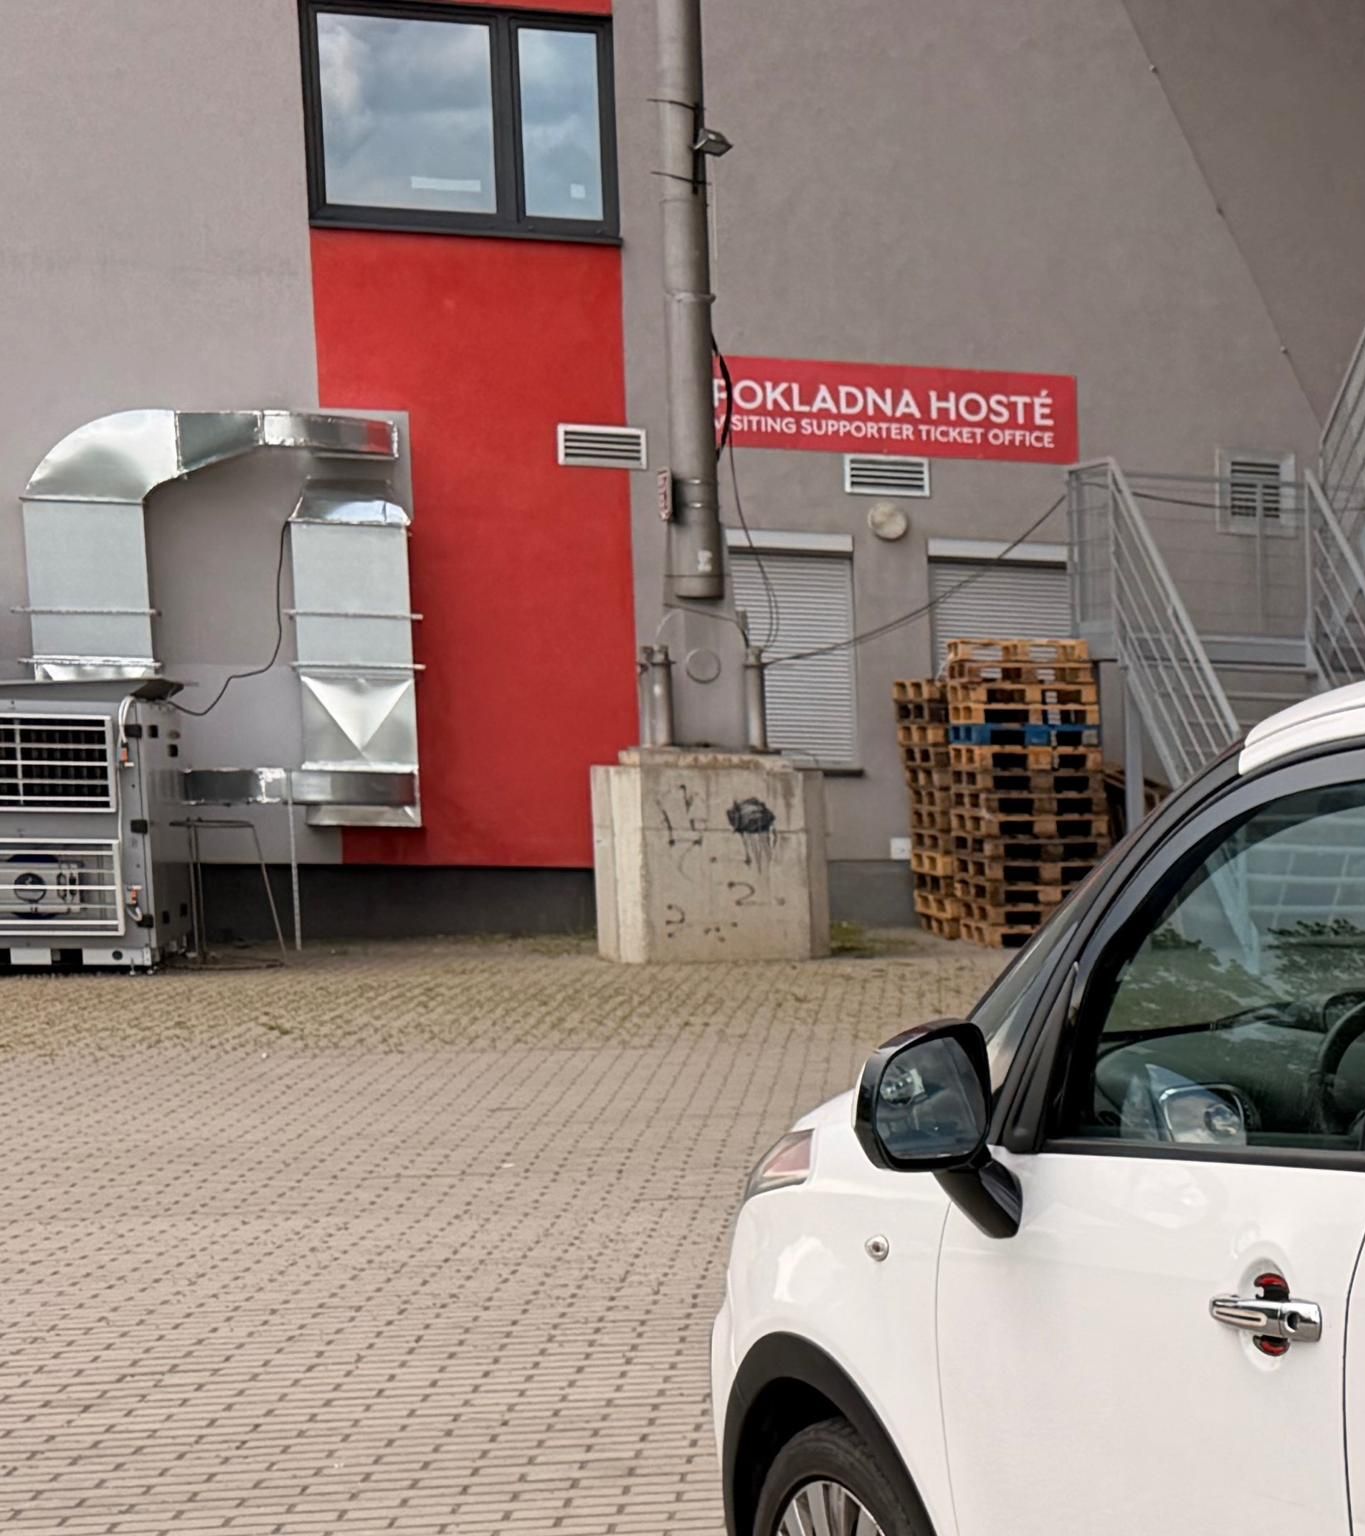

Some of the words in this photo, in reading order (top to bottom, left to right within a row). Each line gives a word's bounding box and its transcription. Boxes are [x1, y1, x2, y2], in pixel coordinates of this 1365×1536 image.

[929, 389, 1055, 427] HOSTÉ
[714, 415, 797, 435] VSITING
[800, 420, 914, 441] SUPPORTER
[918, 426, 984, 445] TICKET
[987, 429, 1055, 449] OFFICE
